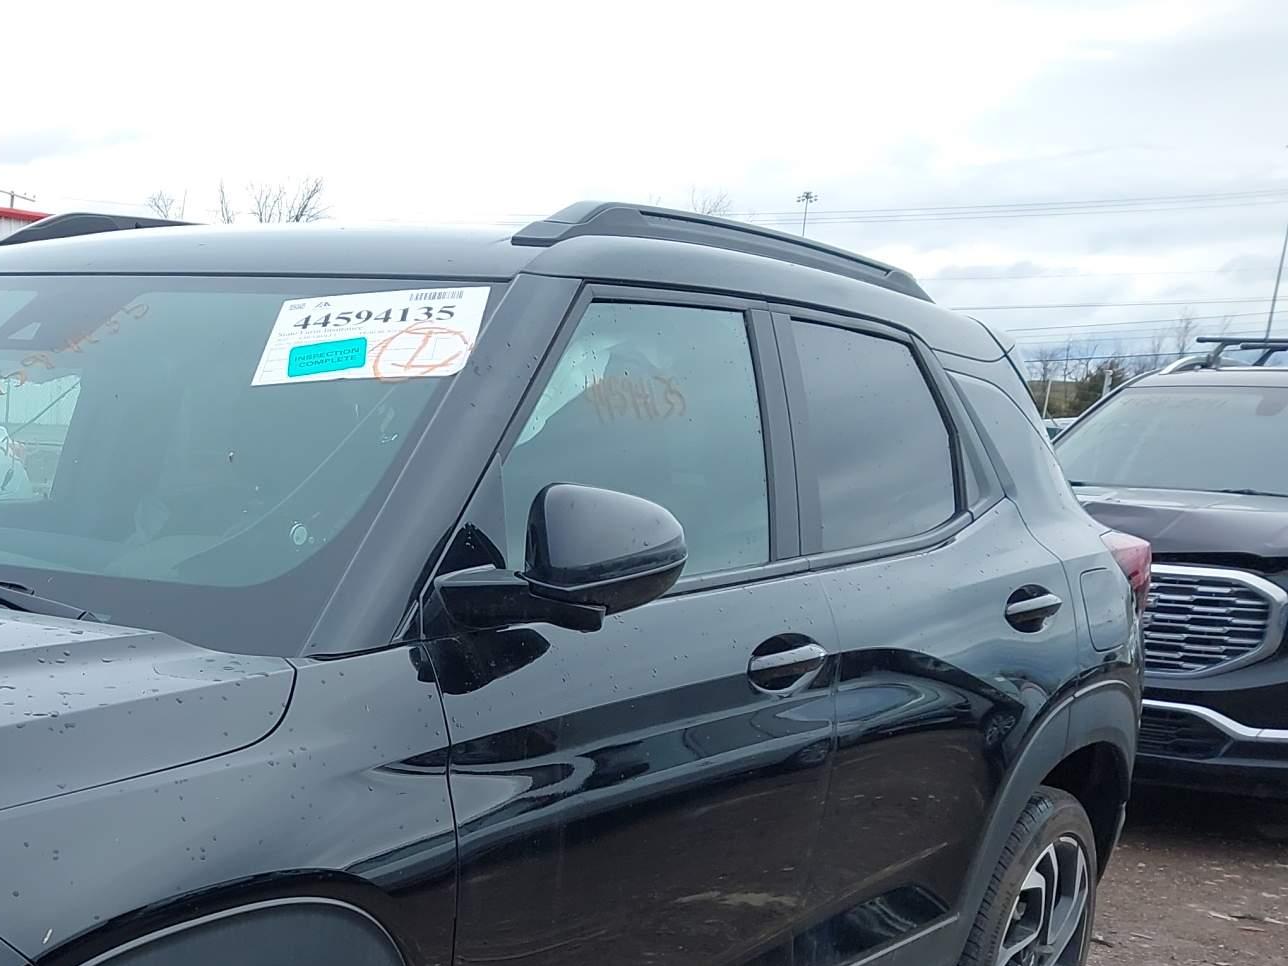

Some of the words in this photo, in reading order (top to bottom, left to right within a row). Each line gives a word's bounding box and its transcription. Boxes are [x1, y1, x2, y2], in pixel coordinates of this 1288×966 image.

[293, 305, 457, 329] 44594135
[295, 347, 360, 362] INSPECTION
[298, 355, 357, 368] COMPLETE
